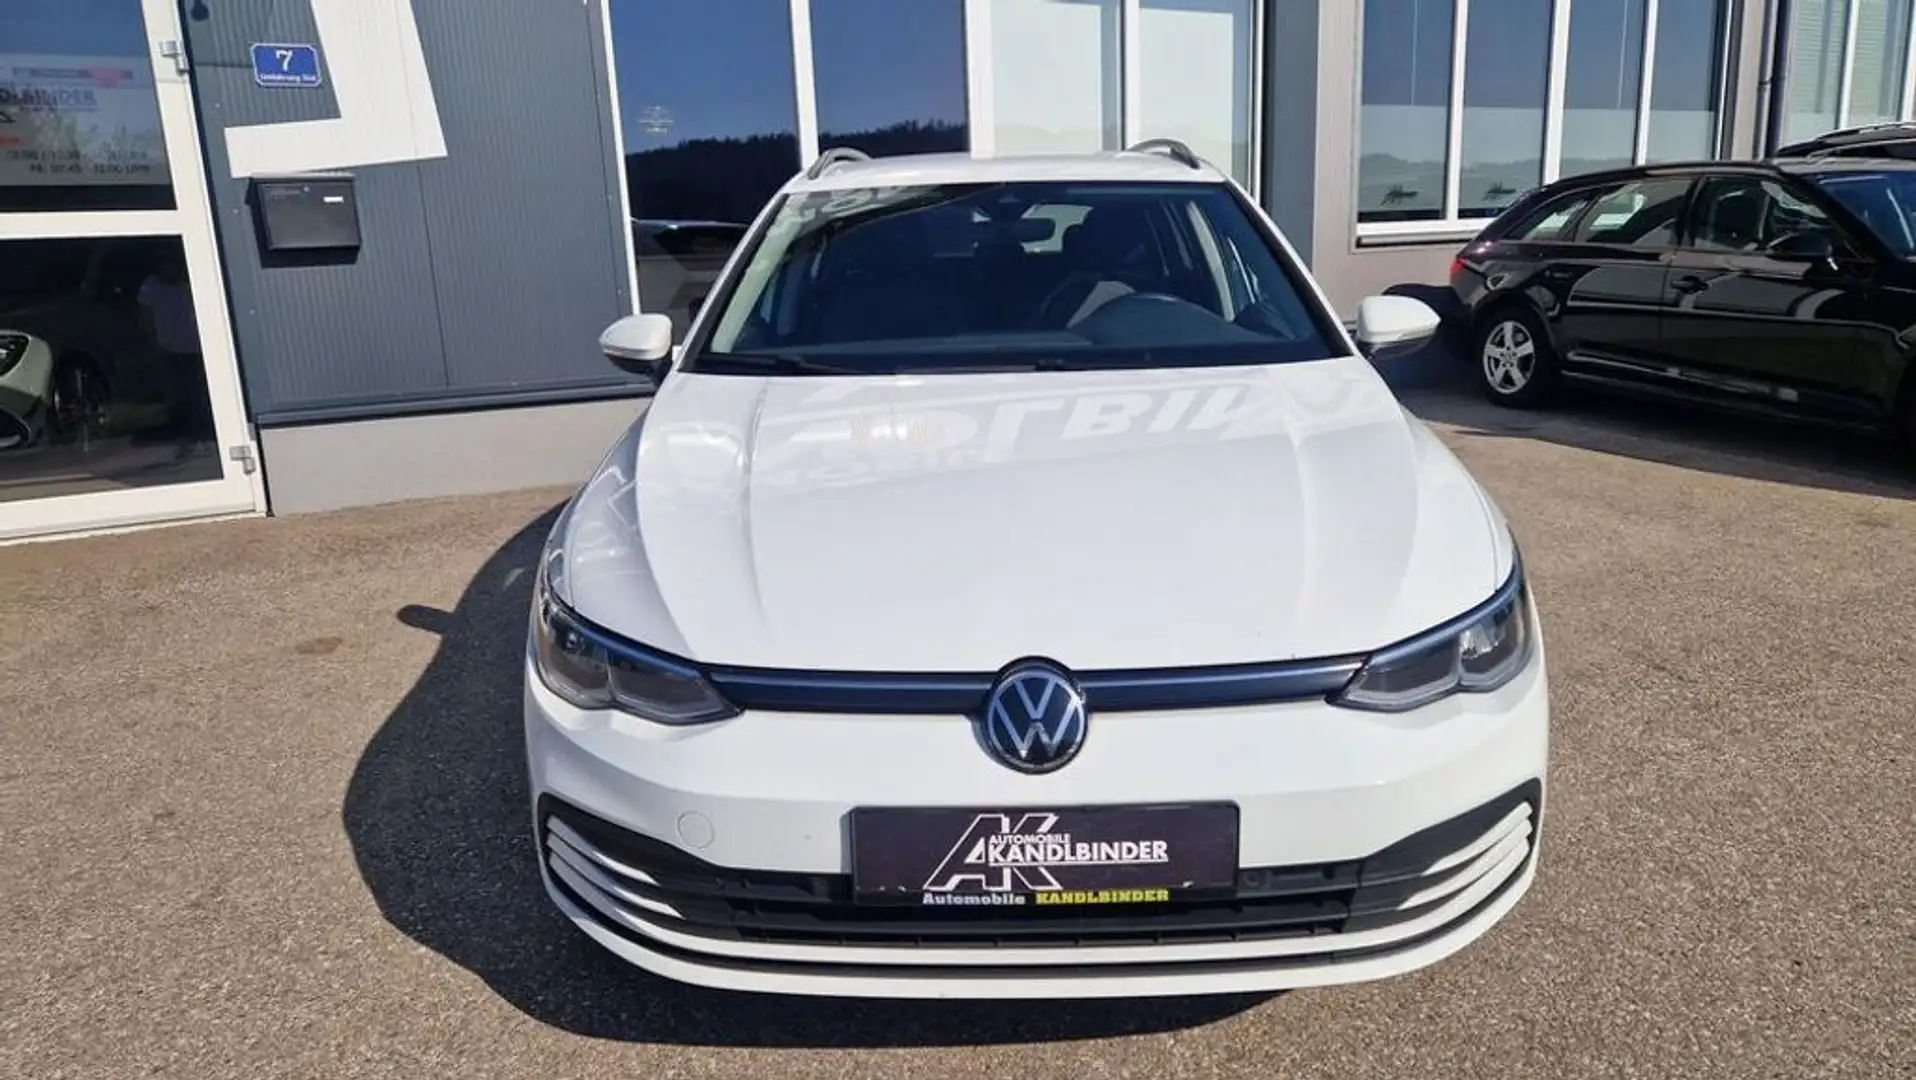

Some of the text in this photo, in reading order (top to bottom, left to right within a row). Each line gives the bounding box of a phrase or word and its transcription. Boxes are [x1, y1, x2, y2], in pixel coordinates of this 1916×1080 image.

[275, 49, 293, 72] 7
[989, 833, 1071, 846] AUTOMOBILE
[988, 840, 1169, 863] KANDLBINDER
[922, 888, 1169, 906] Automobile KANDLBINDER
